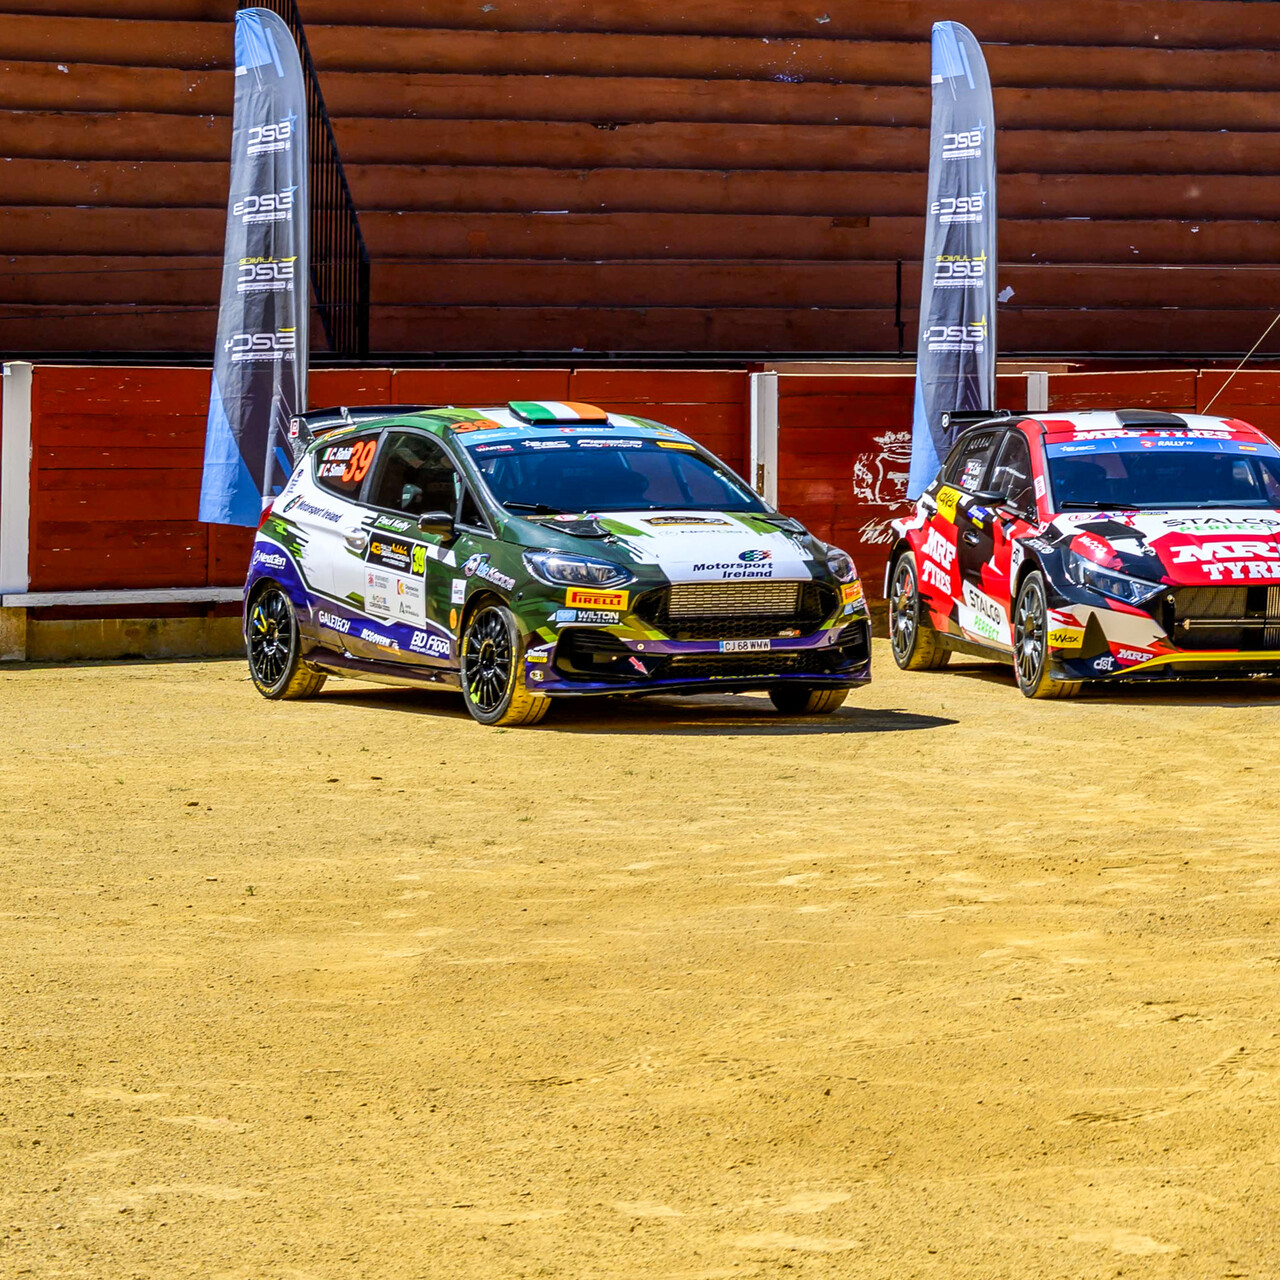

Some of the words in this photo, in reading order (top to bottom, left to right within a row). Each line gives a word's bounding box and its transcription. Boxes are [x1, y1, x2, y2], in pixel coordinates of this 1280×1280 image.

[450, 419, 501, 433] 39
[341, 440, 377, 483] 39
[921, 527, 957, 570] MRF
[693, 561, 773, 572] Motorsport
[722, 570, 772, 579] Ireland
[921, 560, 952, 596] TYRES
[572, 591, 622, 607] PIRELLI
[319, 610, 351, 634] GALETECH
[577, 610, 620, 621] WILTON
[411, 631, 427, 647] BD
[724, 641, 736, 651] CJ
[737, 640, 749, 651] 68
[750, 639, 770, 650] WMW
[1117, 648, 1154, 662] MRF
